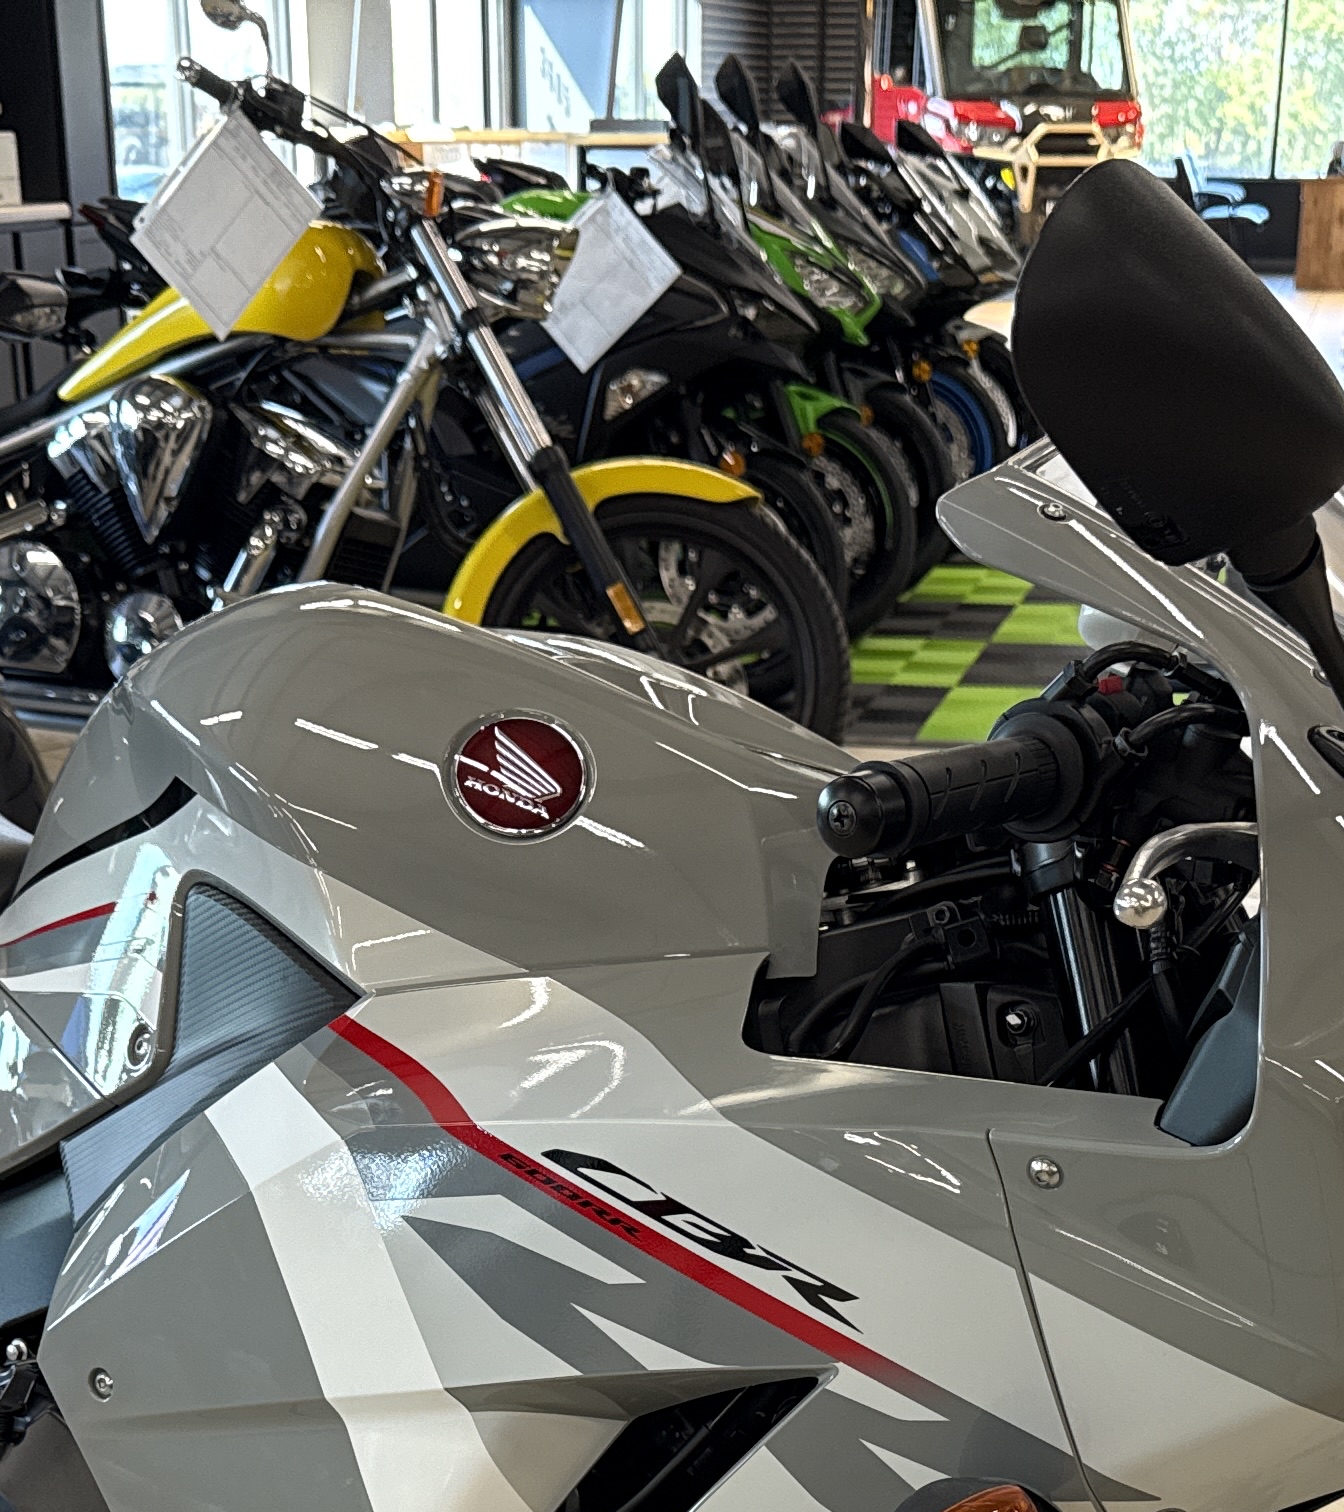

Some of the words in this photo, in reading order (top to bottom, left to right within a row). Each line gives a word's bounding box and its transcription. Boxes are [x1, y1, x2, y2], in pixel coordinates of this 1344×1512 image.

[464, 775, 550, 819] HONDA
[498, 1153, 642, 1242] 600RR
[541, 1149, 864, 1335] CBR
